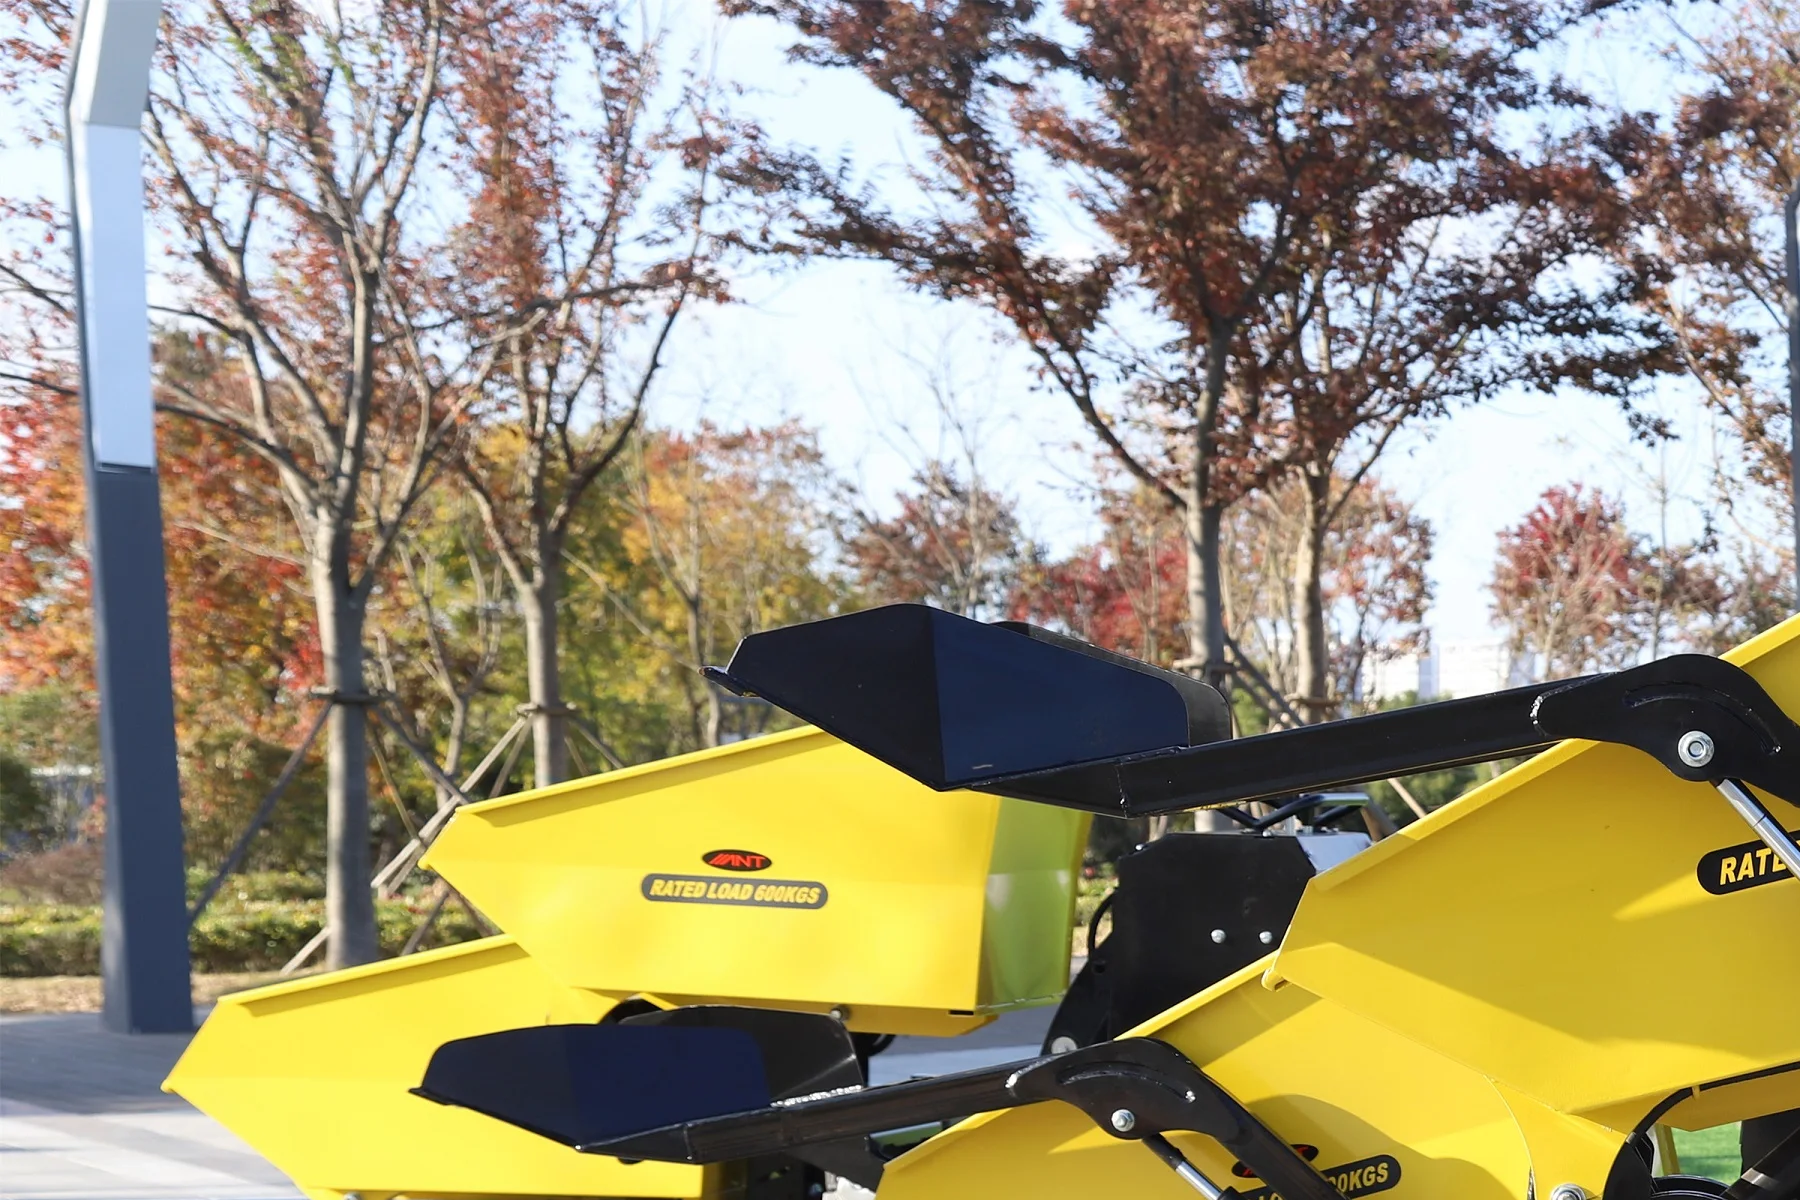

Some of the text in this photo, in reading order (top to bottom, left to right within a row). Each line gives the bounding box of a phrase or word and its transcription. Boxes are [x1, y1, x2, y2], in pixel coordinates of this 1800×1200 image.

[649, 878, 821, 905] RATED LOAD 600KGS
